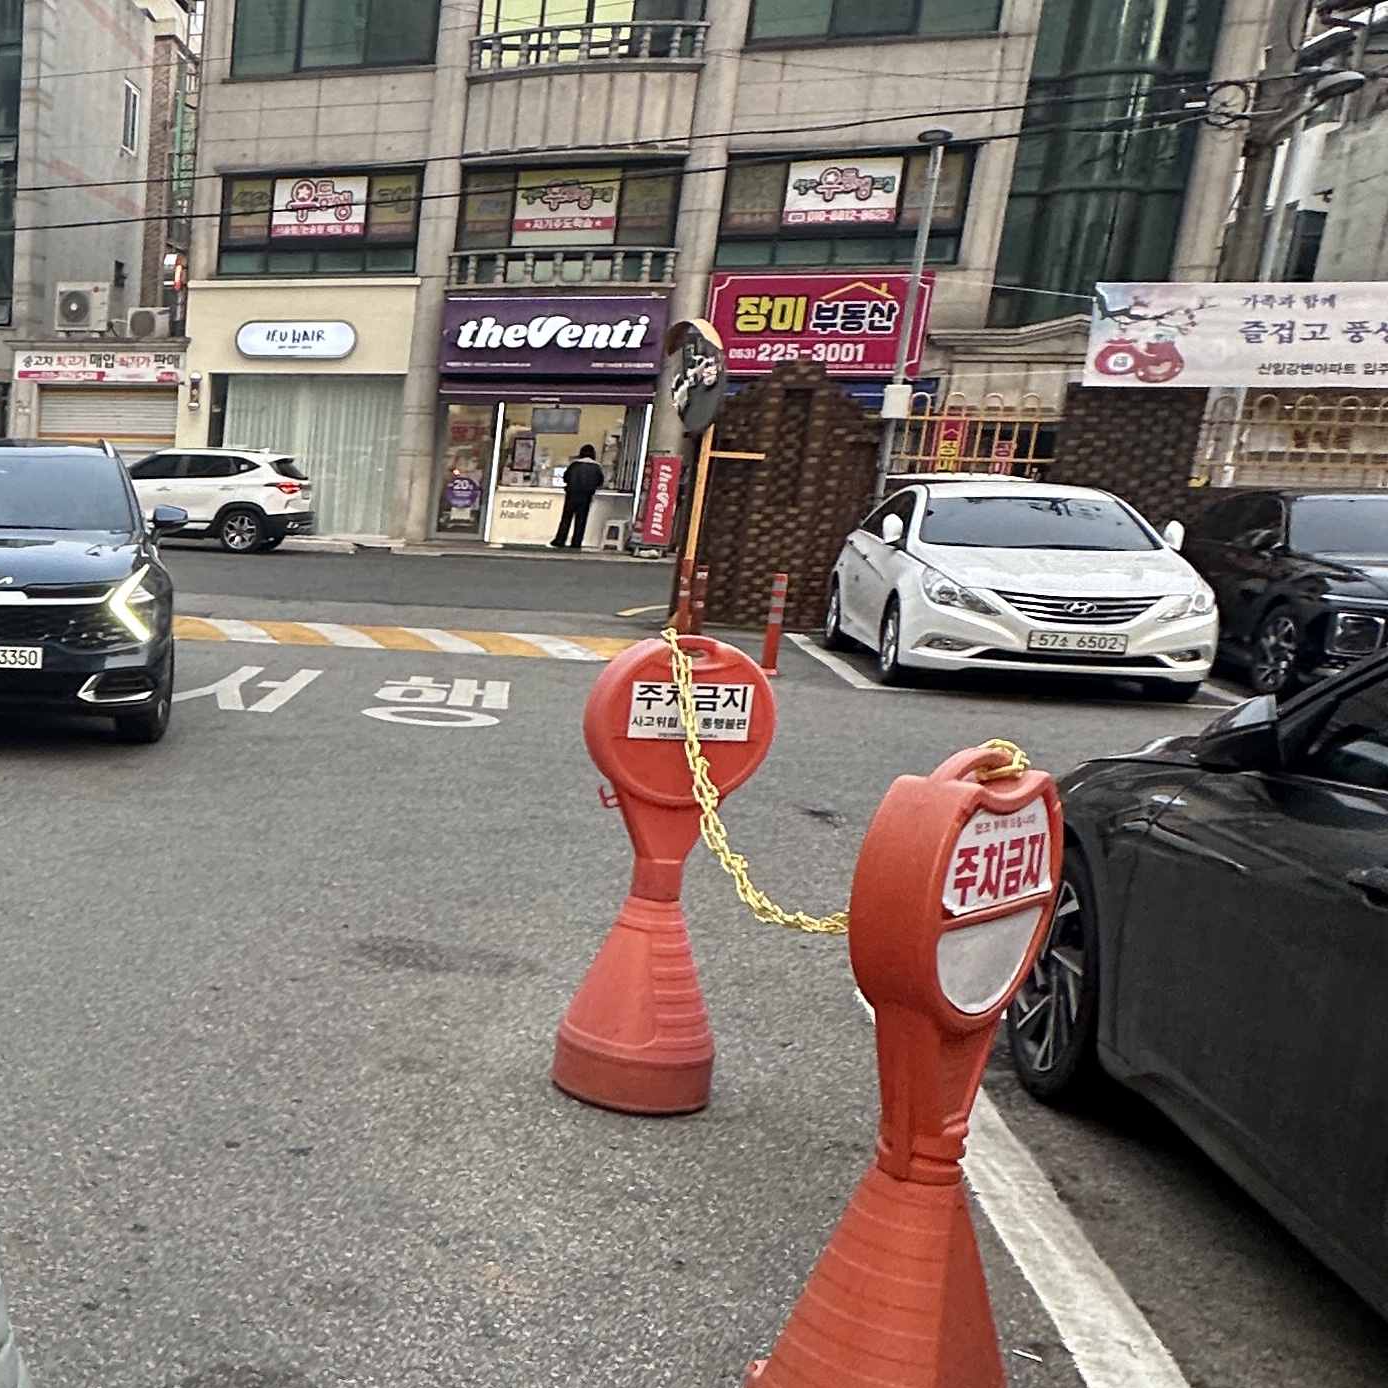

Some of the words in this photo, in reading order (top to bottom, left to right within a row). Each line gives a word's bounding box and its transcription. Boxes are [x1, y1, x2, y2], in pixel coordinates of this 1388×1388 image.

[1242, 294, 1296, 309] 가족과
[735, 296, 808, 332] 장미
[810, 301, 899, 334] 부동산
[456, 315, 651, 349] theVenti
[1239, 320, 1331, 344] 즐겁고
[757, 343, 865, 361] 225-3001
[89, 353, 115, 369] 매입
[154, 353, 181, 370] 판매
[501, 500, 552, 509] theVenti
[1076, 636, 1119, 650] 6502
[631, 715, 679, 729] 사고위험
[701, 717, 748, 730] 통행불편
[953, 832, 1046, 907] 주차금지
